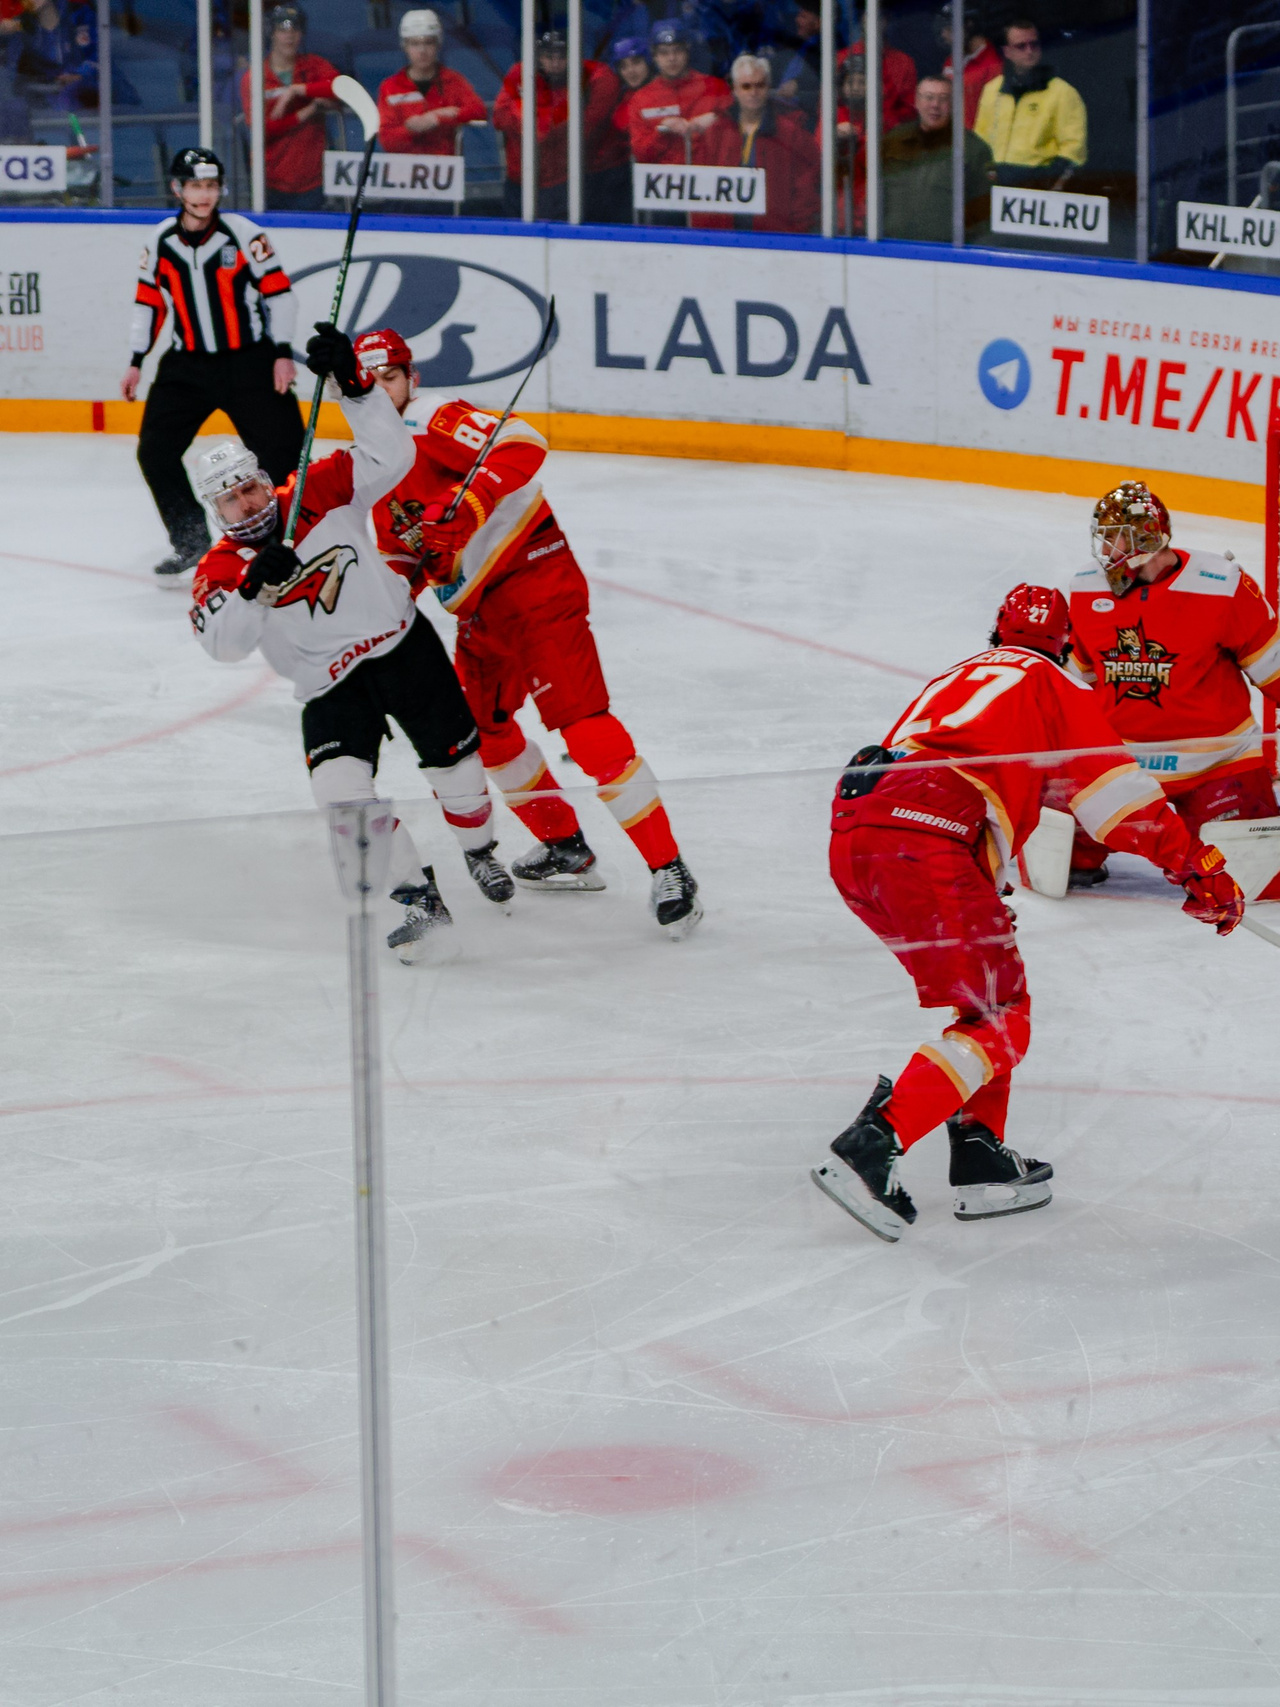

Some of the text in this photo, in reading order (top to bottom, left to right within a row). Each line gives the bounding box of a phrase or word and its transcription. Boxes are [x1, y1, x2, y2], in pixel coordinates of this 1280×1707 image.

[0, 156, 54, 181] аз
[334, 160, 454, 190] KHL.RU
[644, 173, 757, 203] KHL.RU
[1000, 196, 1100, 231] KHL.RU
[1185, 211, 1275, 247] KHL.RU
[0, 271, 41, 315] 部
[595, 293, 871, 385] LADA
[1053, 315, 1080, 332] МЫ
[1089, 318, 1152, 341] ВСЕГДА
[1161, 327, 1181, 344] НА
[1190, 330, 1241, 352] СВЯЗИ
[453, 411, 500, 450] 84
[527, 540, 565, 560] BAUER
[1028, 606, 1049, 624] 27
[1103, 661, 1174, 686] REDSTAR
[891, 806, 969, 836] WARRIOR
